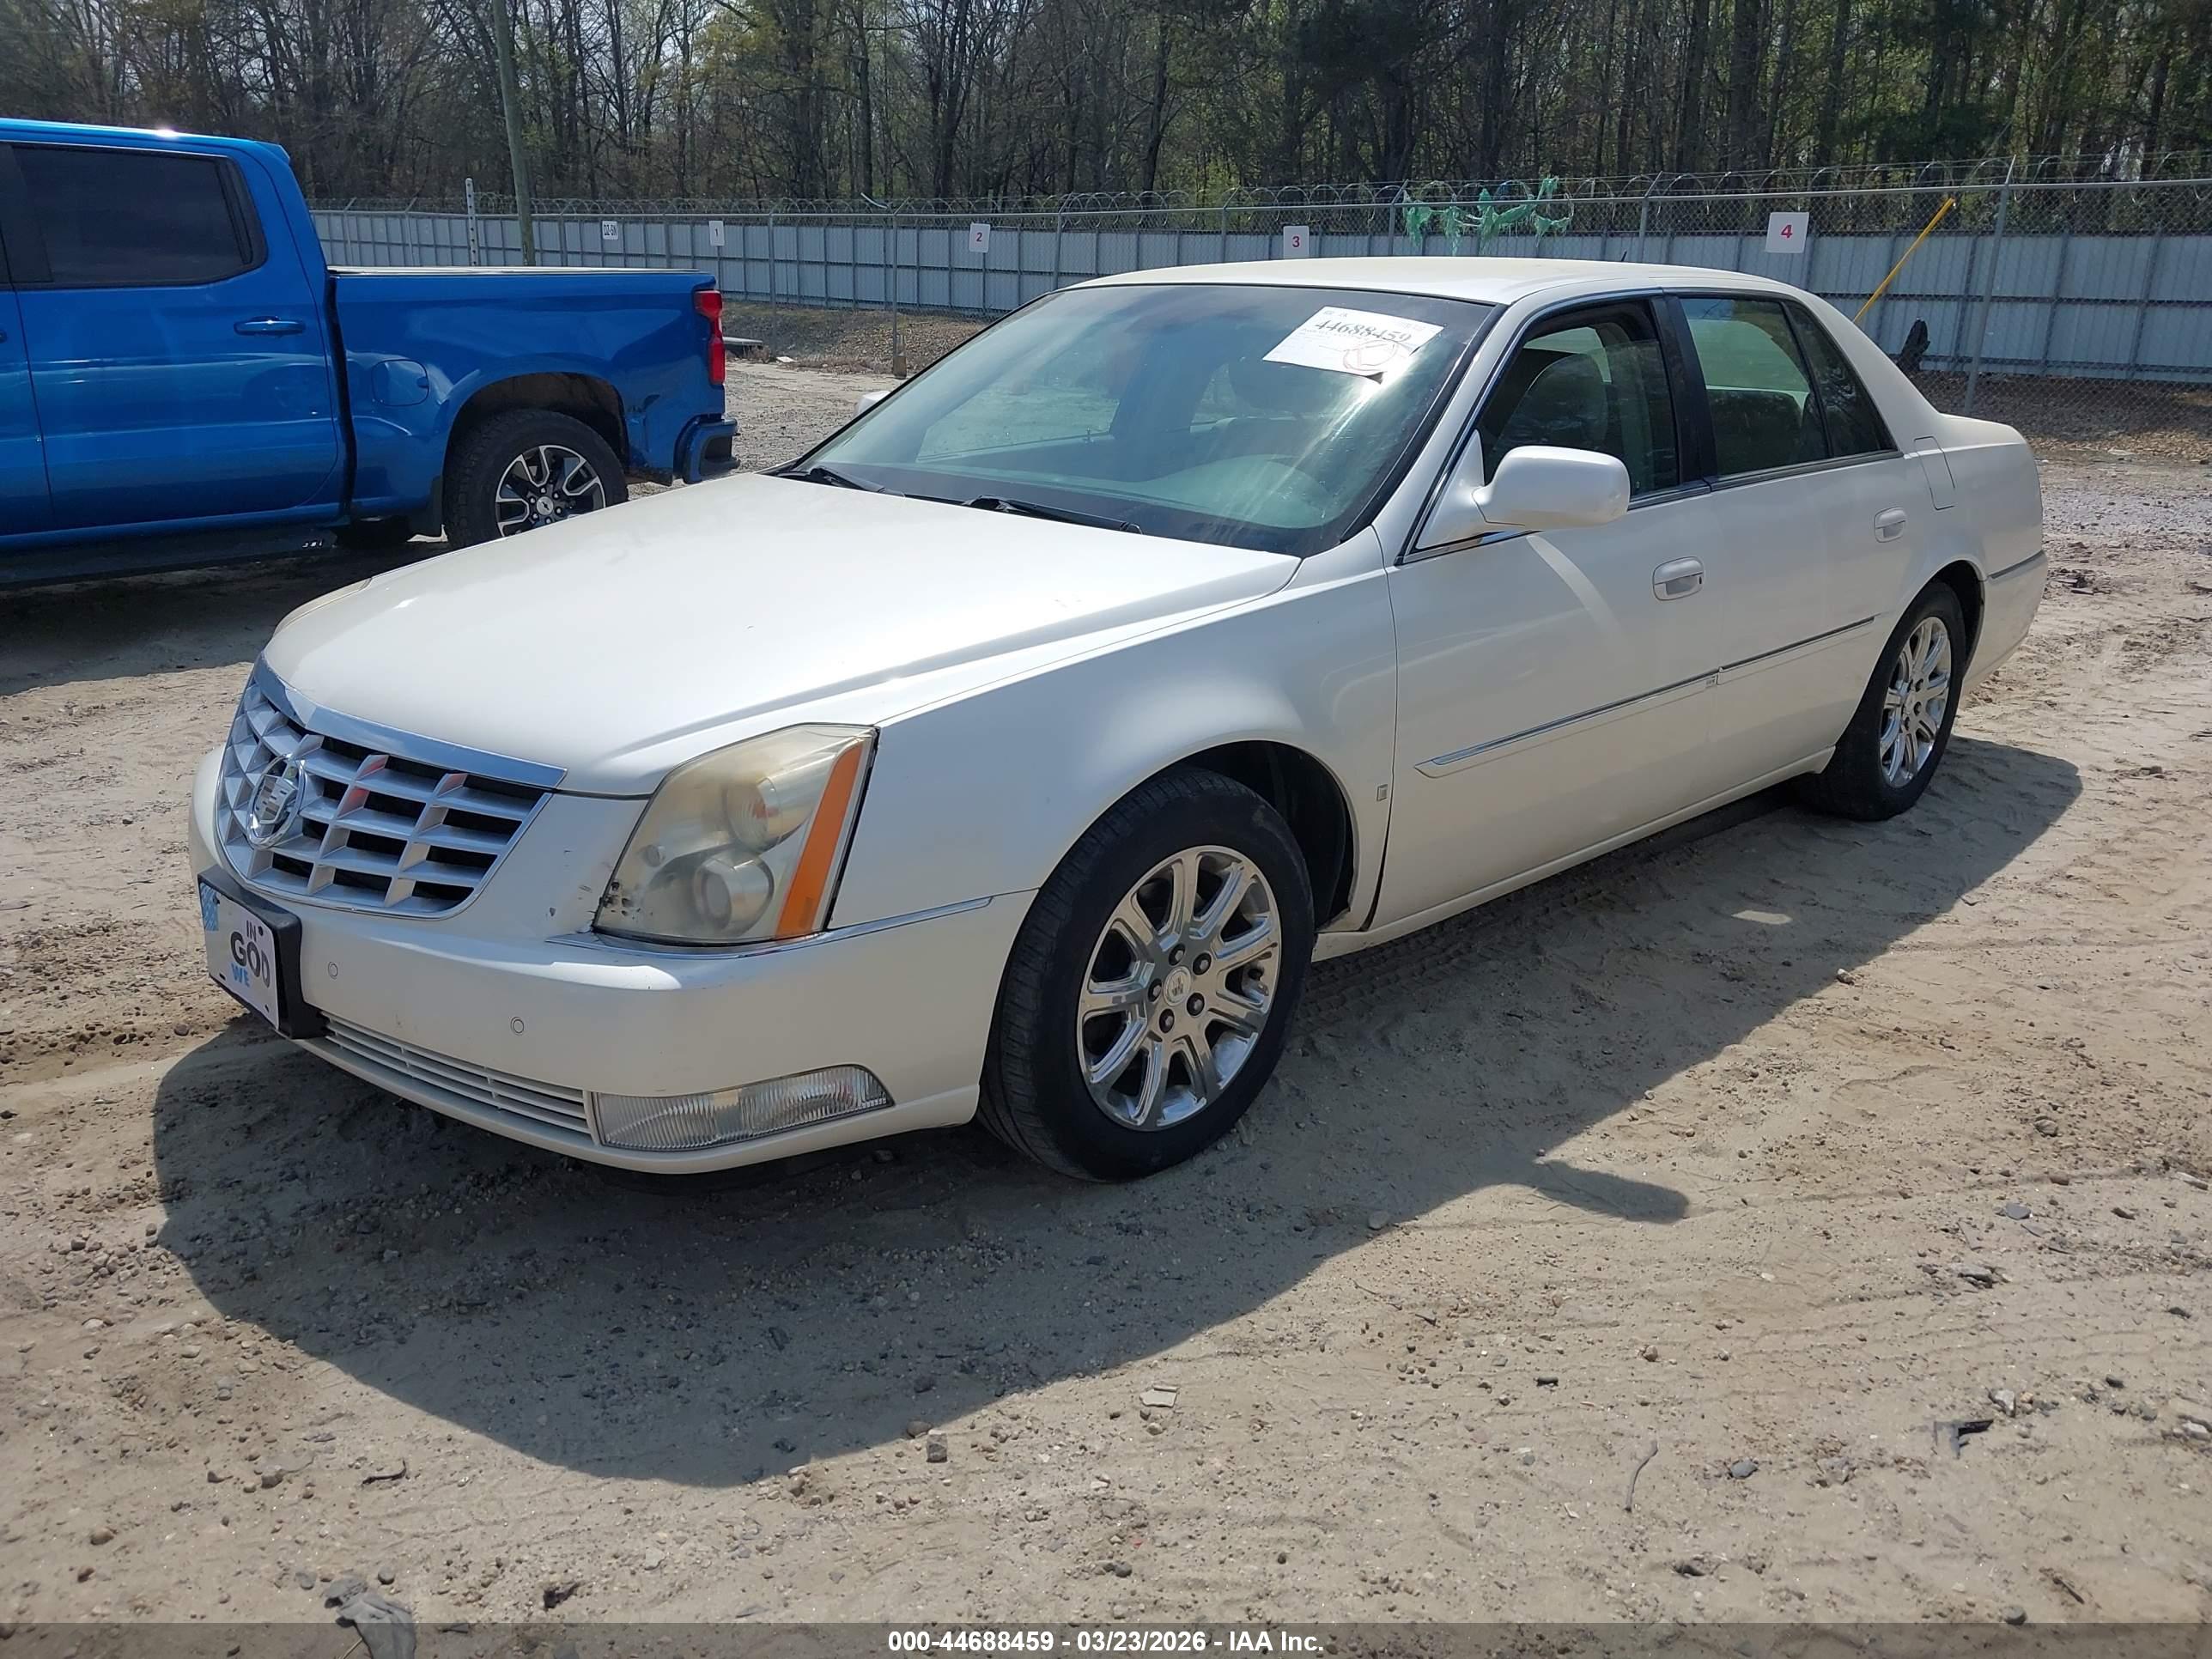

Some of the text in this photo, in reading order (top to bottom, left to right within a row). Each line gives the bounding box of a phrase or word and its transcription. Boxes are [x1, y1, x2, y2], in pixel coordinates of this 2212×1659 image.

[976, 232, 983, 242] 2
[1291, 235, 1300, 248] 3
[1781, 224, 1793, 239] 4
[1315, 319, 1412, 343] 44688459
[246, 920, 257, 942] IN
[230, 931, 270, 988] GOD
[230, 963, 251, 988] WE
